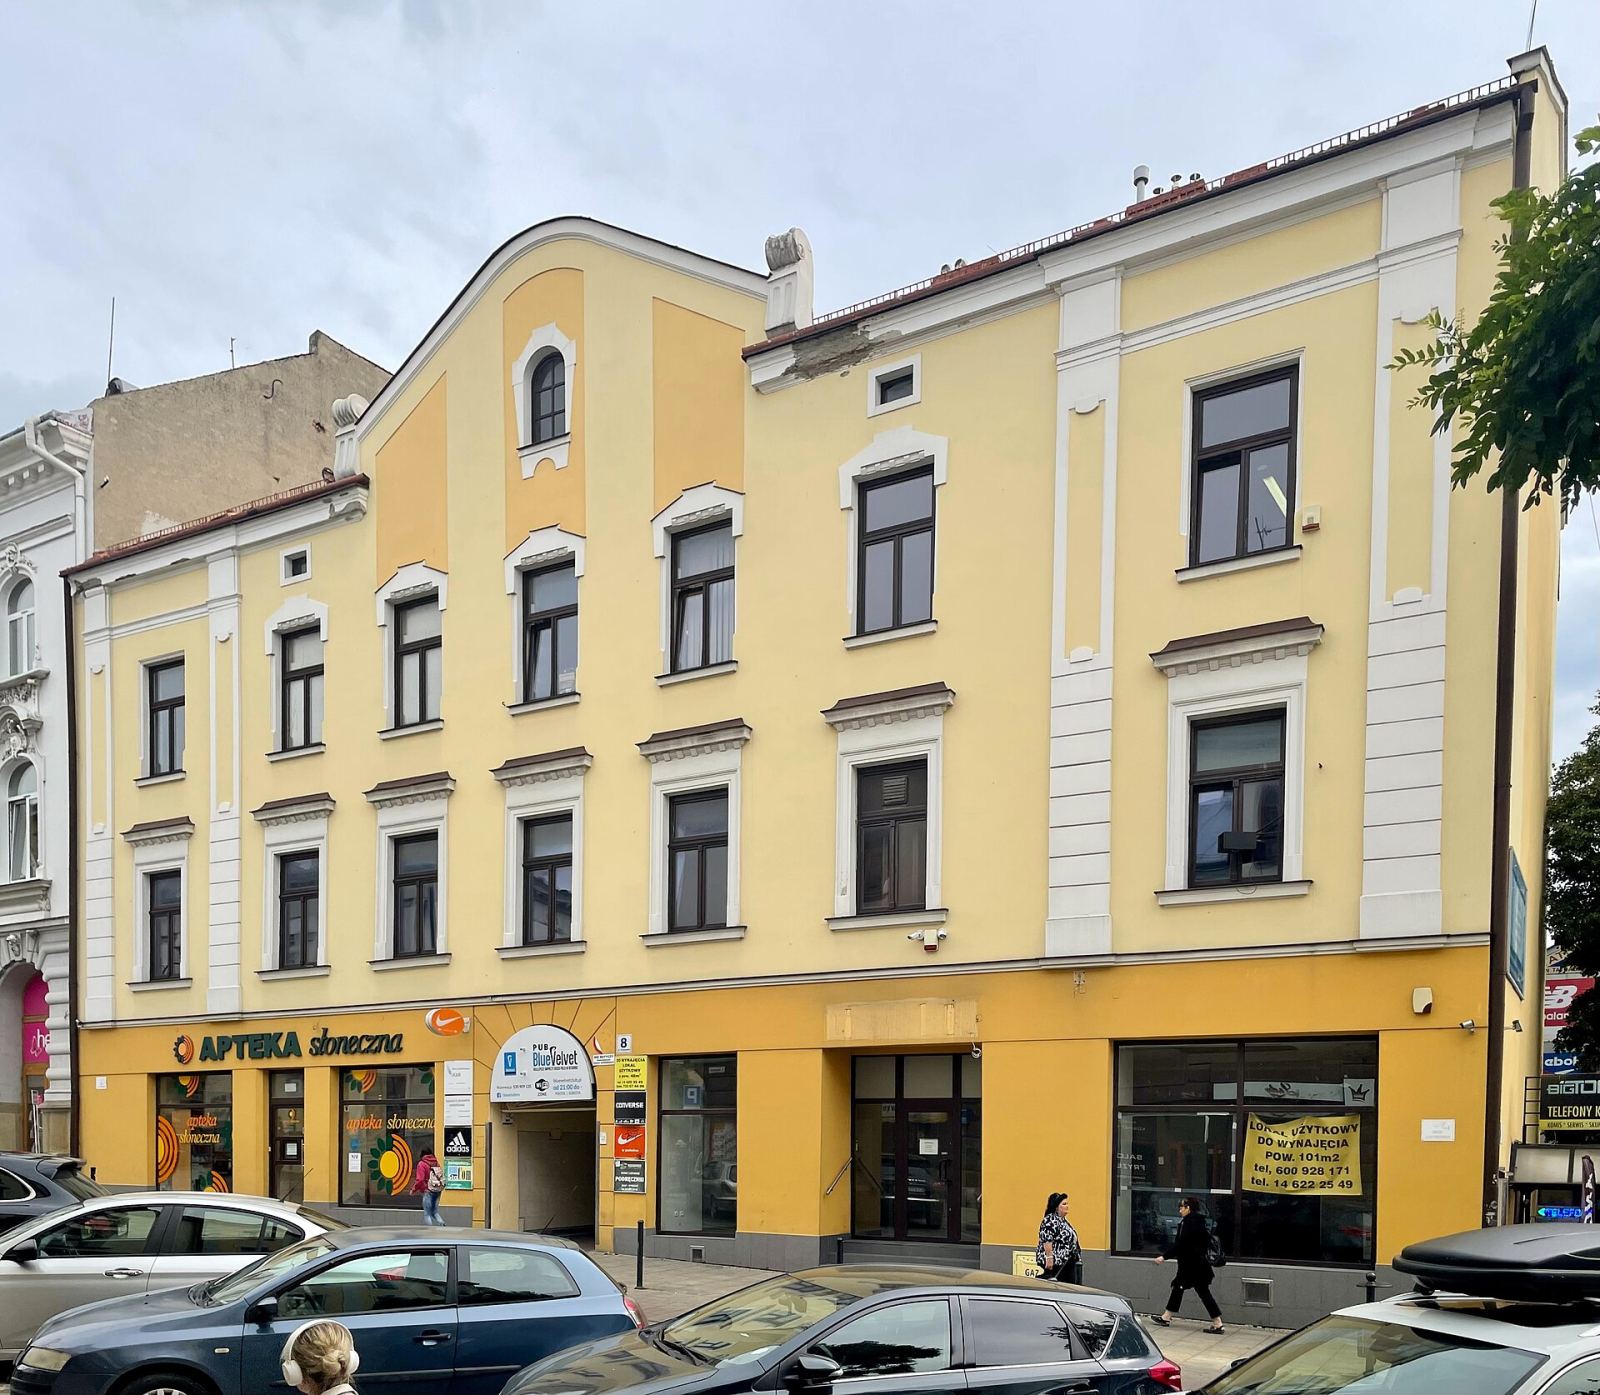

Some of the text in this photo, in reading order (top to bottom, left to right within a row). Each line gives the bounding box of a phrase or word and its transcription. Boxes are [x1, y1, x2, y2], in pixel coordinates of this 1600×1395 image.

[199, 1028, 403, 1061] APTEKA słoneczna
[532, 1043, 549, 1051] PUB
[620, 1037, 628, 1048] 8
[1547, 1105, 1592, 1117] TELEFONY
[187, 1113, 217, 1130] apteka
[346, 1114, 382, 1133] apteka
[1292, 1123, 1358, 1137] UŻYTKOWY
[180, 1130, 220, 1144] słoneczna
[1257, 1136, 1349, 1150] DO WYNAJĘCIA
[446, 1144, 470, 1152] adidas
[1265, 1151, 1340, 1162] POW. 101m2
[1276, 1166, 1298, 1175] 600
[1302, 1167, 1324, 1175] 928
[1329, 1167, 1349, 1175] 171
[1251, 1176, 1353, 1189] tel. 14 622 25 49
